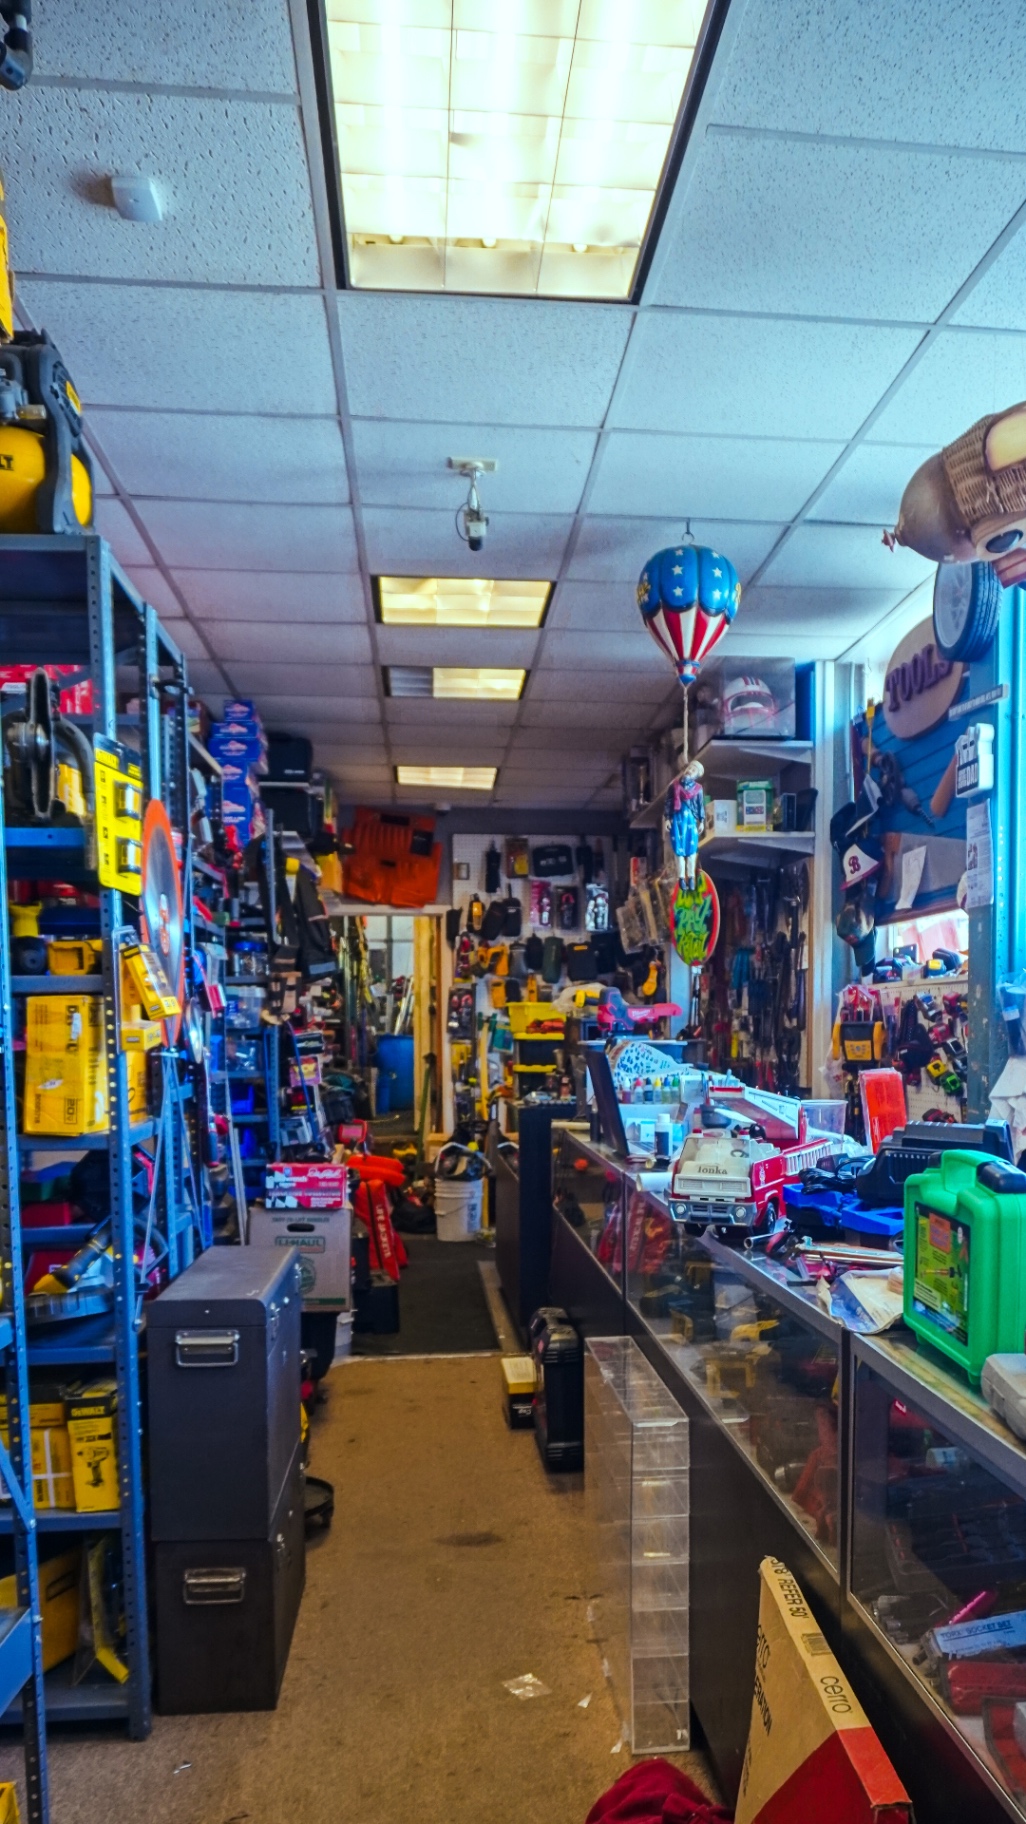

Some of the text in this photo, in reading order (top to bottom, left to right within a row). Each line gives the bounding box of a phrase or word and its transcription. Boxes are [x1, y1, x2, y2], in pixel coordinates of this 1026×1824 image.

[848, 855, 861, 874] B
[777, 1578, 804, 1606] REFER
[965, 1623, 996, 1635] SOCKET
[820, 1675, 852, 1714] cerro
